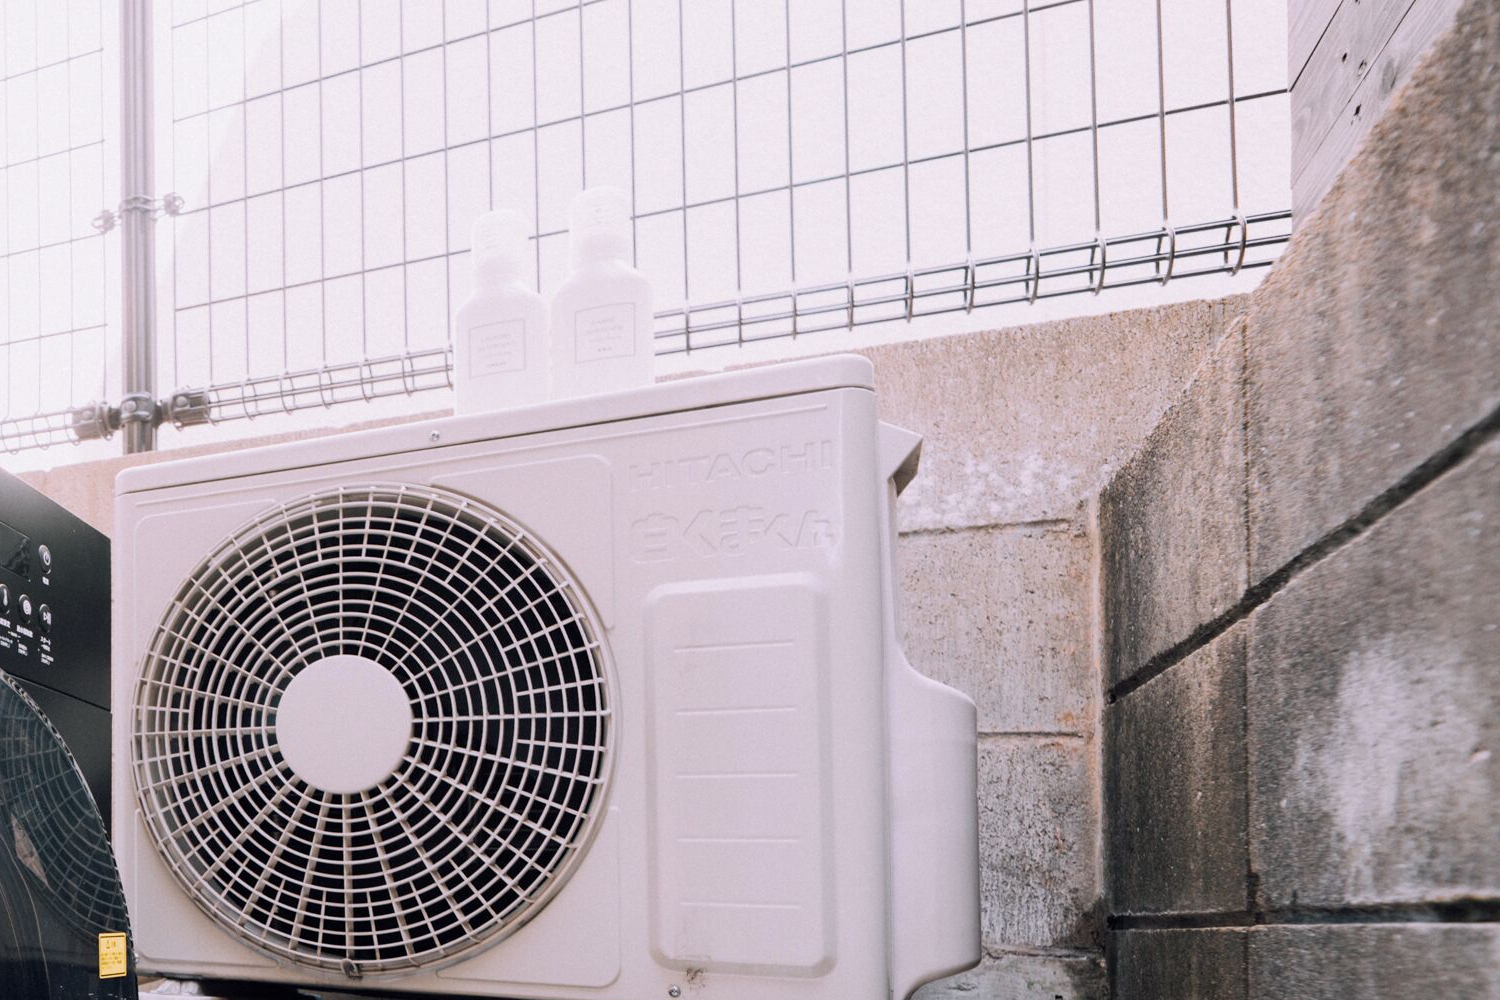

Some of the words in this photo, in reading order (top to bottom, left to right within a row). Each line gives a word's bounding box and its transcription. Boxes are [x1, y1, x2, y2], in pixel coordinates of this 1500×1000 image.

[629, 440, 833, 492] HITACHI
[630, 505, 835, 564] 白くまくん
